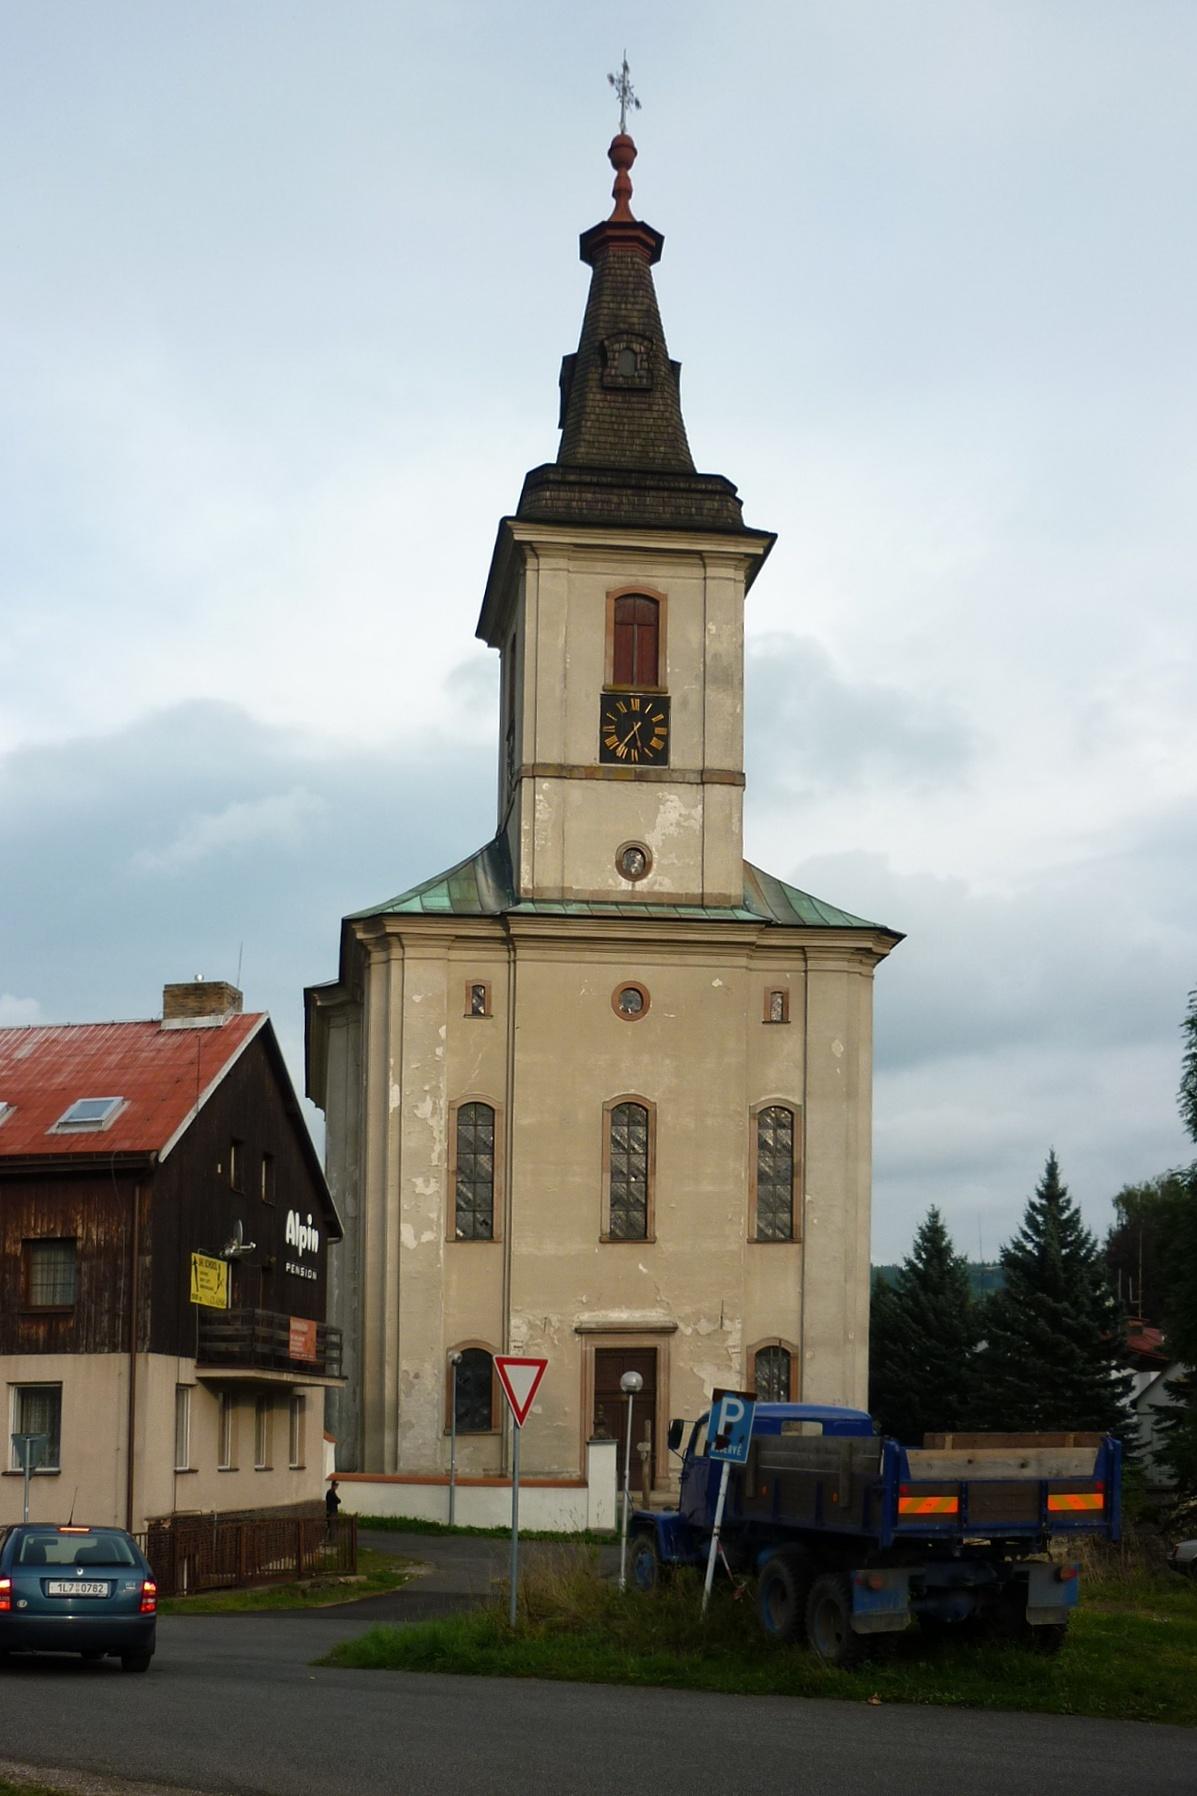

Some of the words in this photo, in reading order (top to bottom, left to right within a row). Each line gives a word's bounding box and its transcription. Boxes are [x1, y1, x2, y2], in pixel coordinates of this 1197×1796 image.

[285, 1209, 319, 1257] Alpin
[285, 1262, 318, 1280] PENSION
[718, 1396, 745, 1435] P
